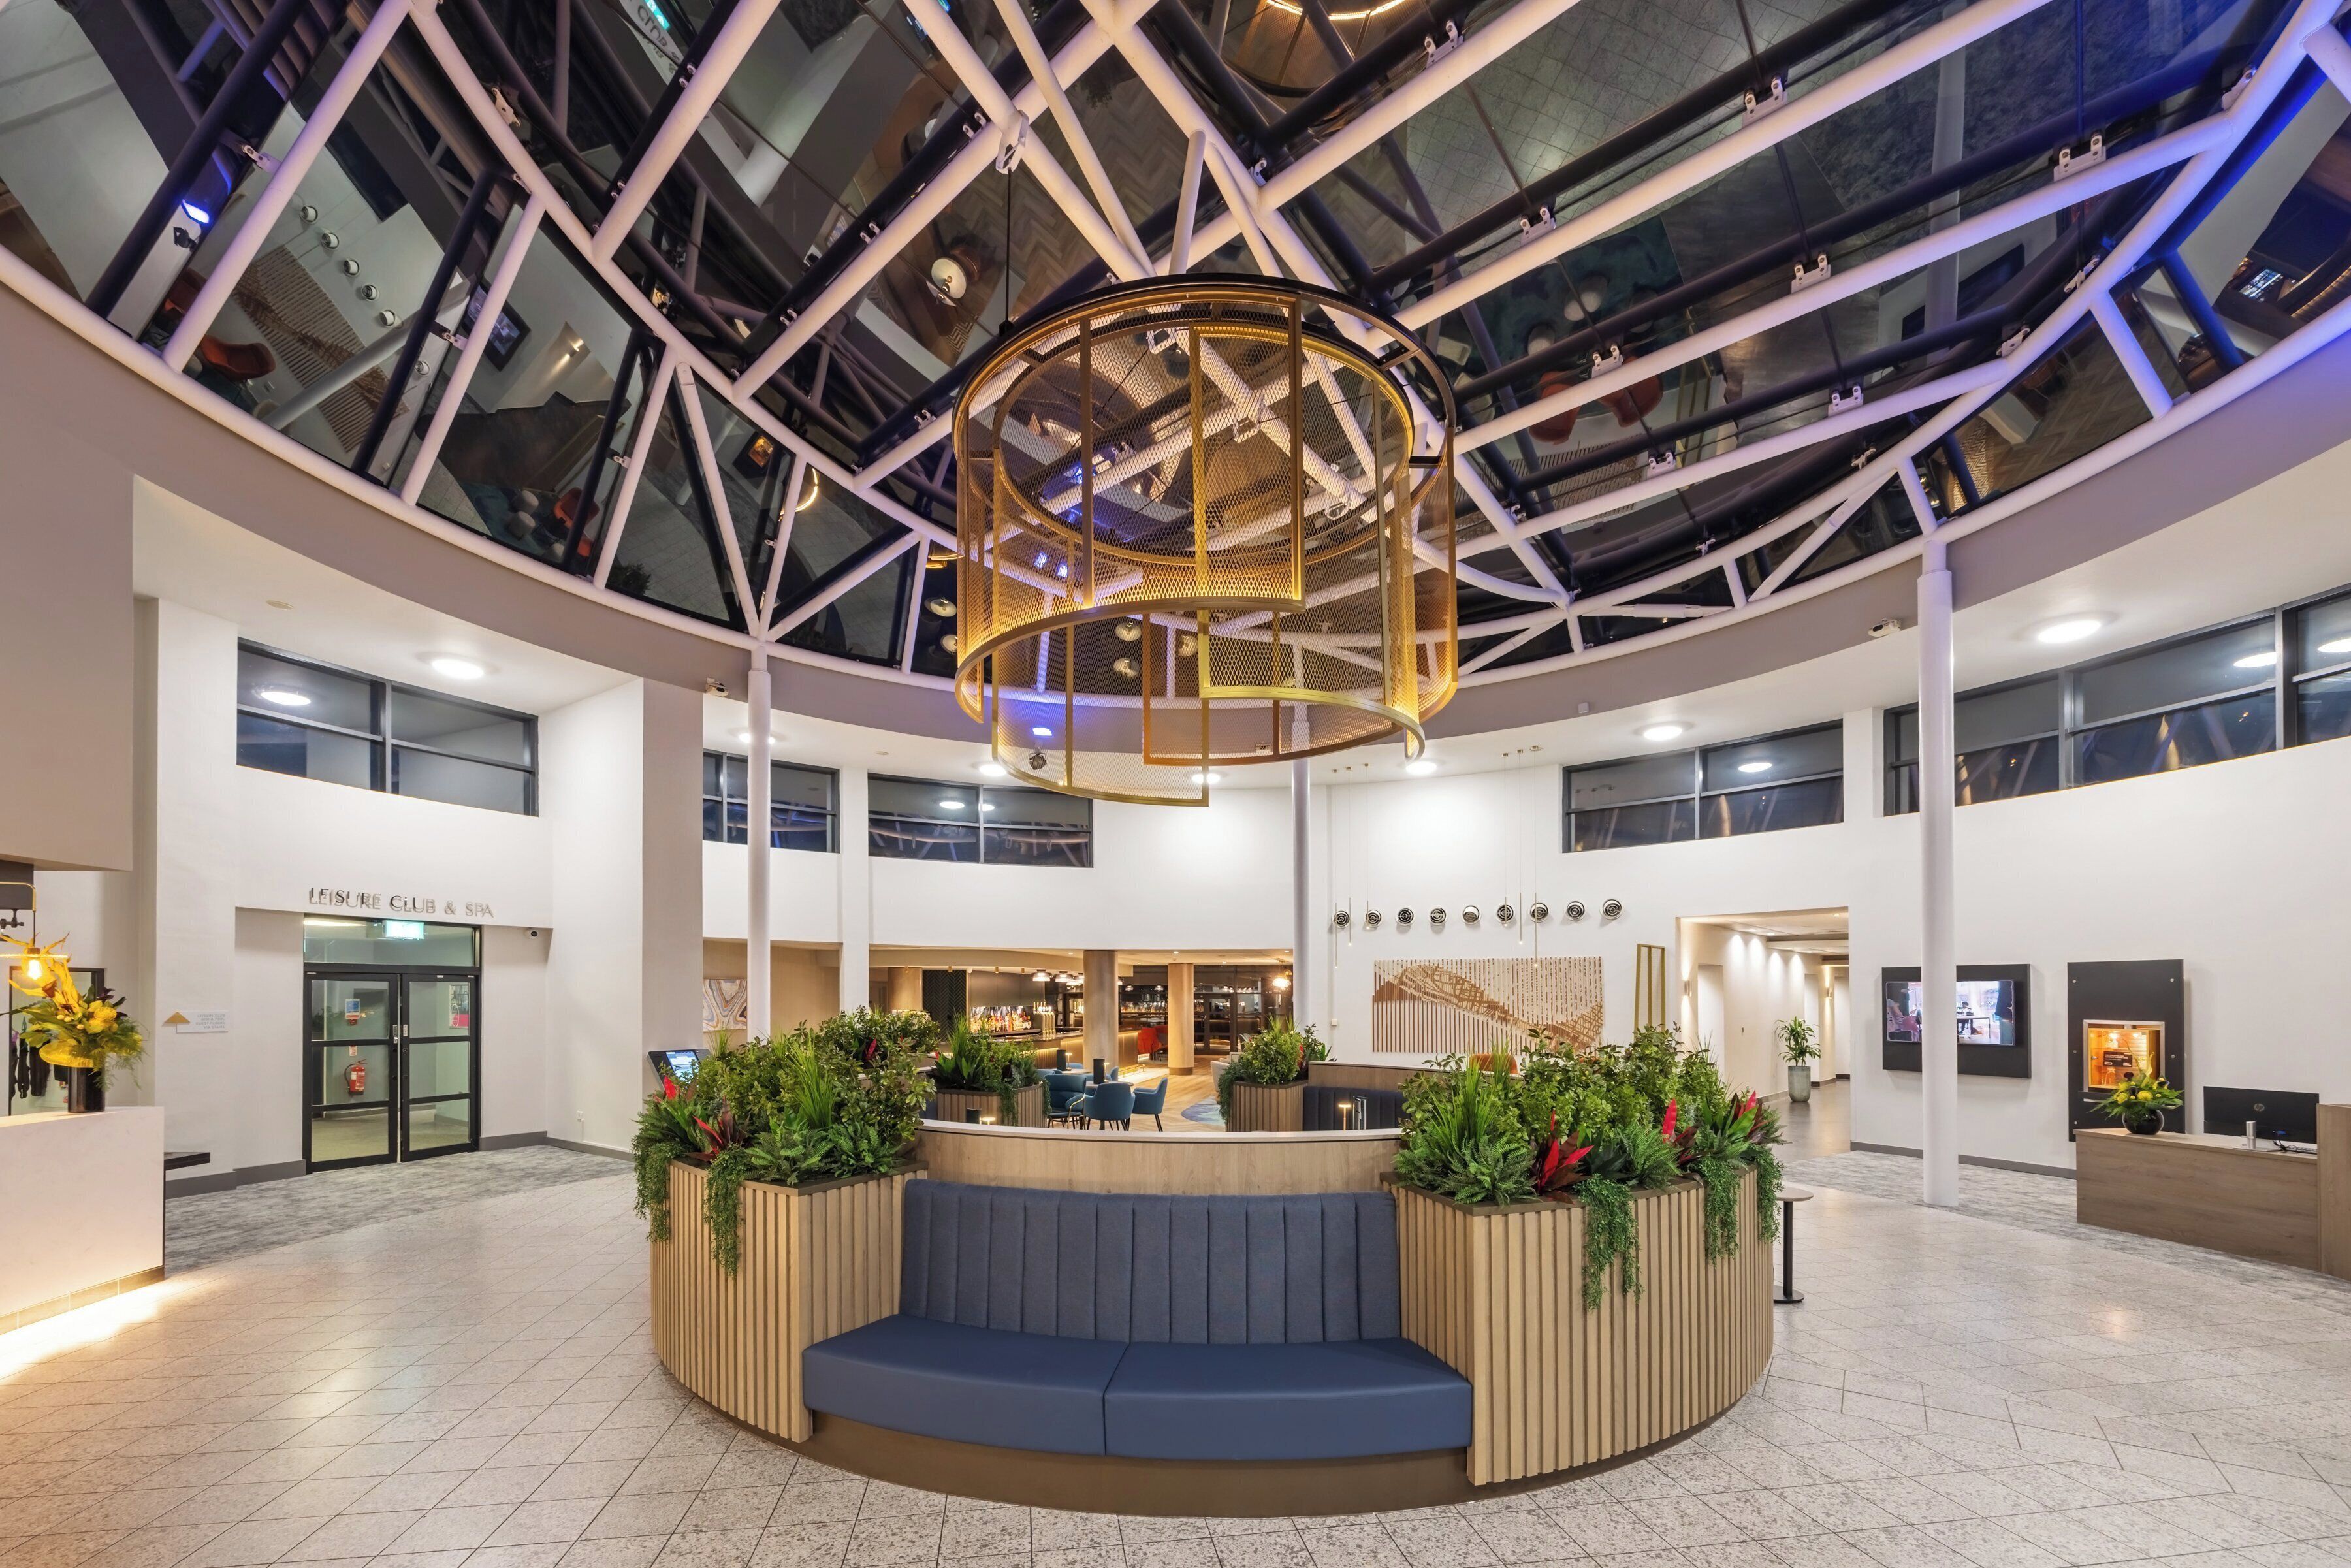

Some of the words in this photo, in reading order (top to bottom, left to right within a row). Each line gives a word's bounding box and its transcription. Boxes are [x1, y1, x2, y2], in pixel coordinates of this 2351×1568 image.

[309, 888, 381, 910] LEISURE
[389, 895, 436, 914] CLUB
[444, 900, 456, 915] &
[466, 902, 494, 918] SPA
